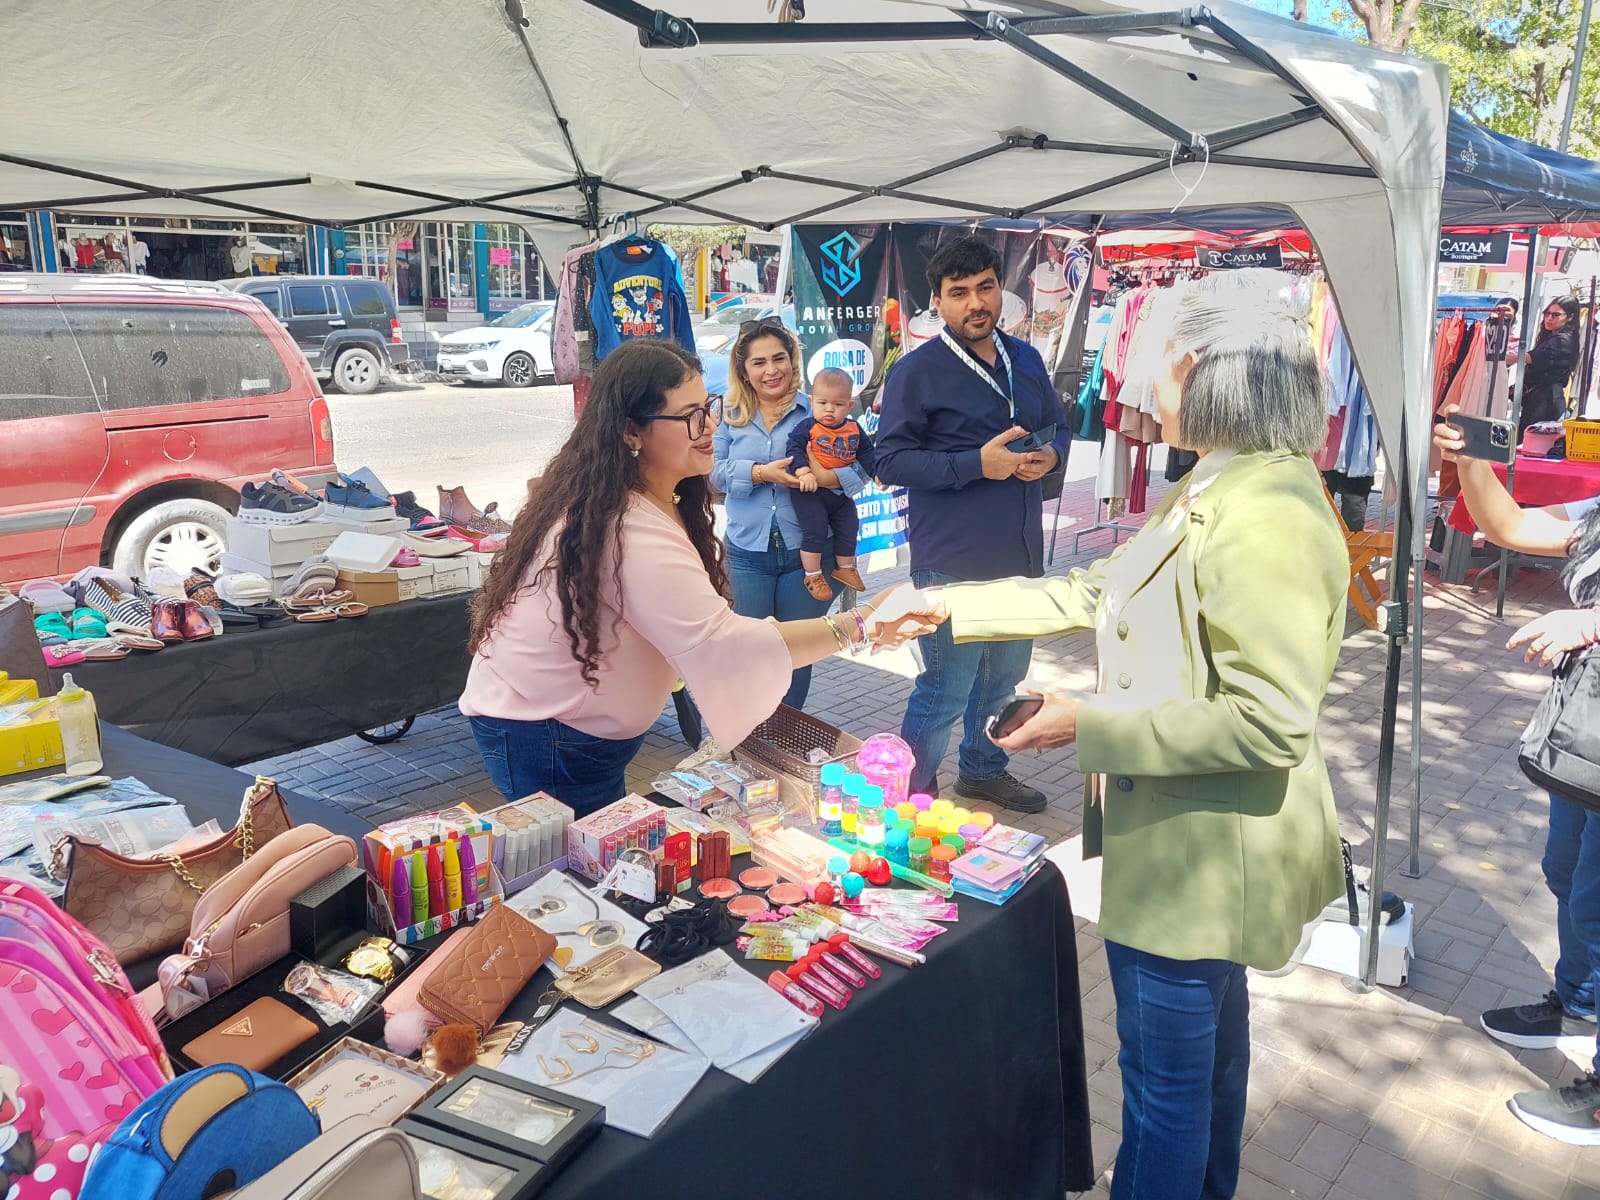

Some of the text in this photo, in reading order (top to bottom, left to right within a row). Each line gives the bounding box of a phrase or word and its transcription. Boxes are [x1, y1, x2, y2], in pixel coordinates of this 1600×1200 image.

[1440, 238, 1492, 252] CATAM
[1222, 252, 1267, 263] CATAM
[623, 322, 657, 336] PUP!
[824, 349, 866, 368] BOLSA DE
